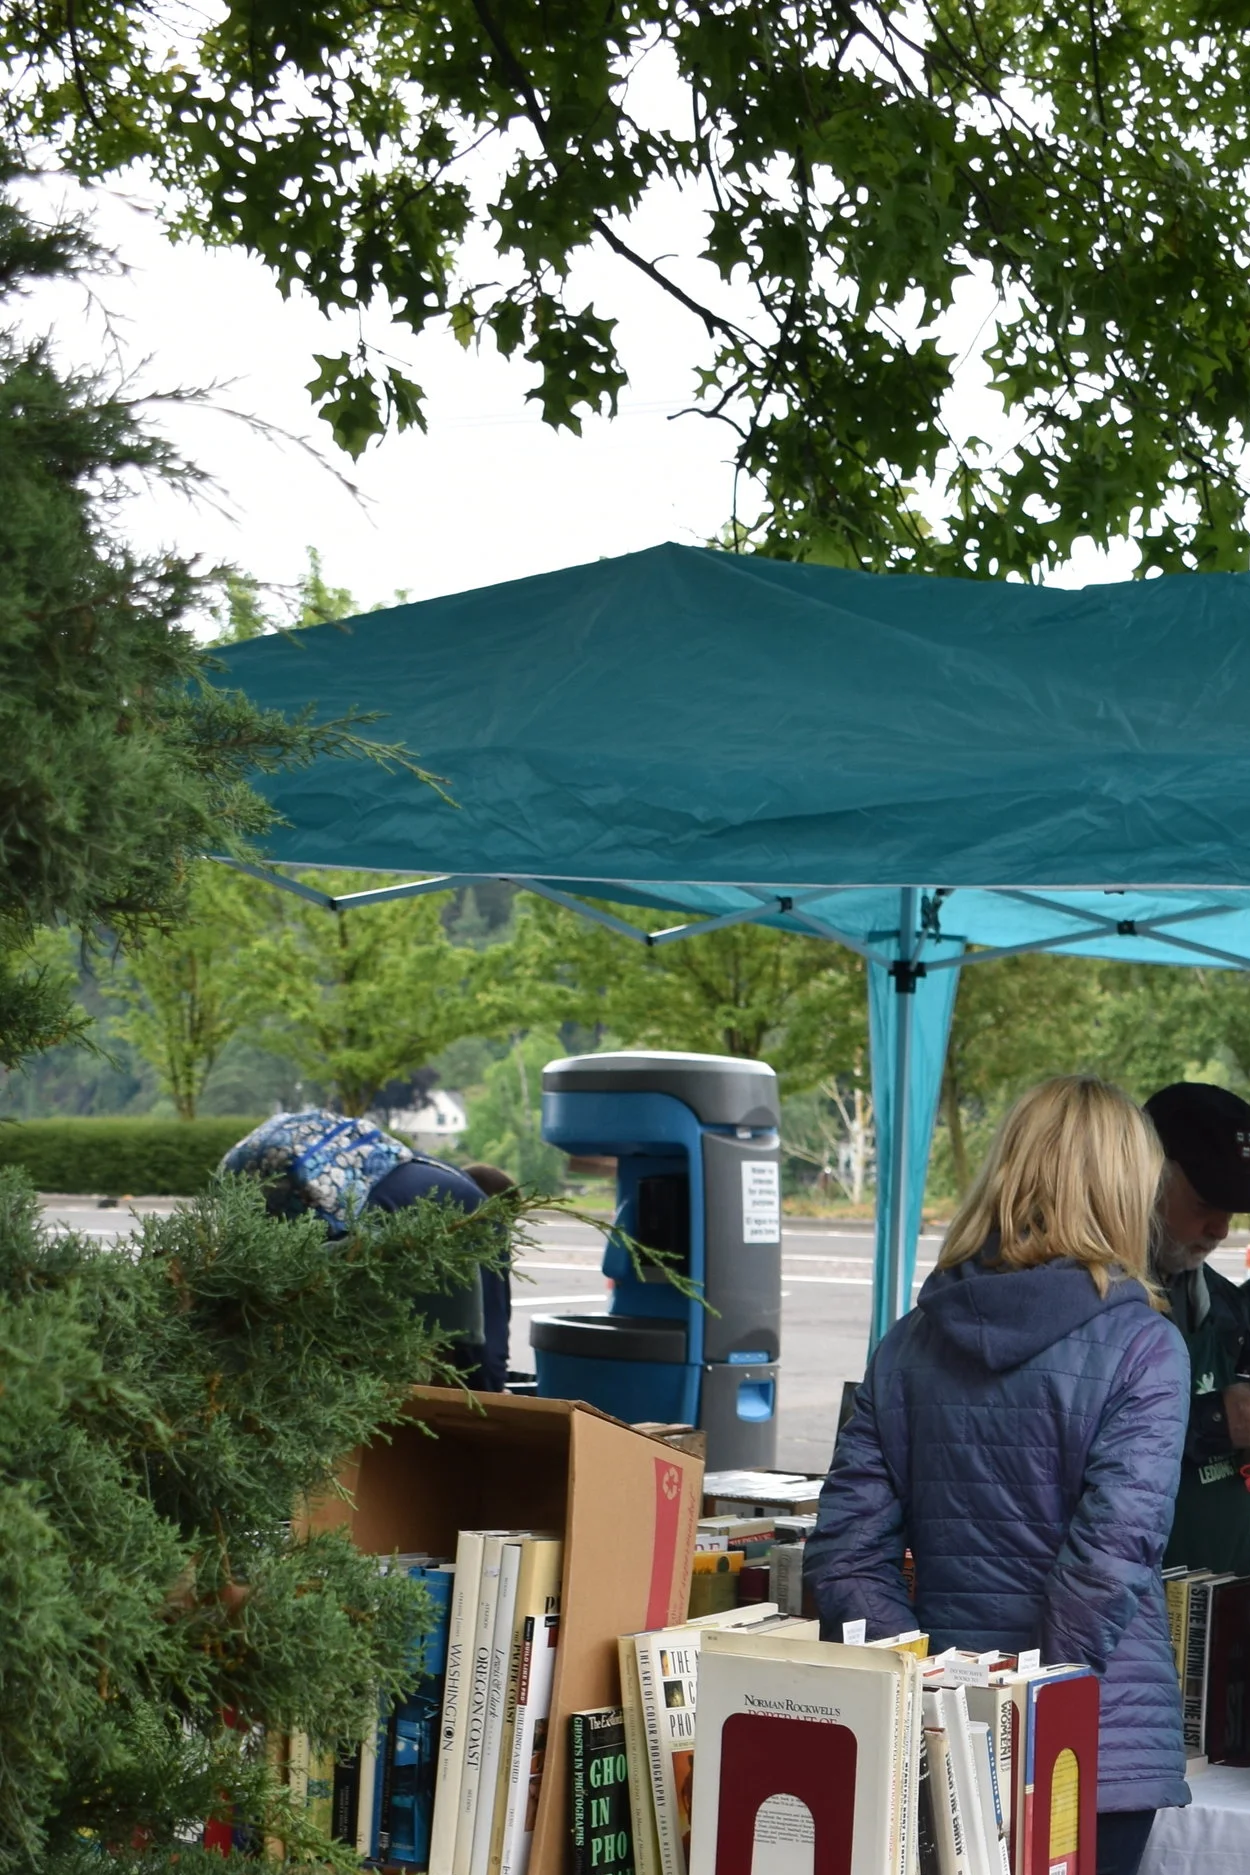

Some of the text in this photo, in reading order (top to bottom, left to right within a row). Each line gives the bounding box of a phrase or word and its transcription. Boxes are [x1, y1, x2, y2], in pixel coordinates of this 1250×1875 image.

[1174, 1611, 1183, 1643] SCOTT
[492, 1648, 505, 1679] Lewis
[509, 1644, 522, 1689] PACIFIC
[523, 1641, 532, 1662] BUILD
[671, 1650, 691, 1675] THE
[1183, 1587, 1208, 1749] STEVE MARTINI THE LIST
[472, 1646, 490, 1715] OREGON
[522, 1663, 530, 1680] LIKE
[954, 1675, 967, 1683] BOOKS
[958, 1668, 969, 1677] YOU
[970, 1670, 983, 1678] HAVE
[442, 1643, 463, 1752] WASHINGTON
[505, 1690, 518, 1725] COAST
[744, 1694, 841, 1717] NORMAN ROCKWELL'S
[467, 1716, 484, 1773] COAST
[513, 1706, 525, 1750] BUILDING
[573, 1716, 584, 1756] GHOSTS
[640, 1649, 666, 1808] THE ART OF COLOR PHOTOGRAPHY
[1000, 1700, 1010, 1757] WOMEN
[511, 1759, 521, 1784] SHED
[574, 1757, 584, 1769] IN
[589, 1753, 627, 1789] GHO
[574, 1771, 585, 1846] PHOTOGRAPHS
[590, 1796, 611, 1829] IN
[949, 1791, 958, 1815] THE
[591, 1830, 627, 1868] PHO
[952, 1816, 962, 1856] EARTH
